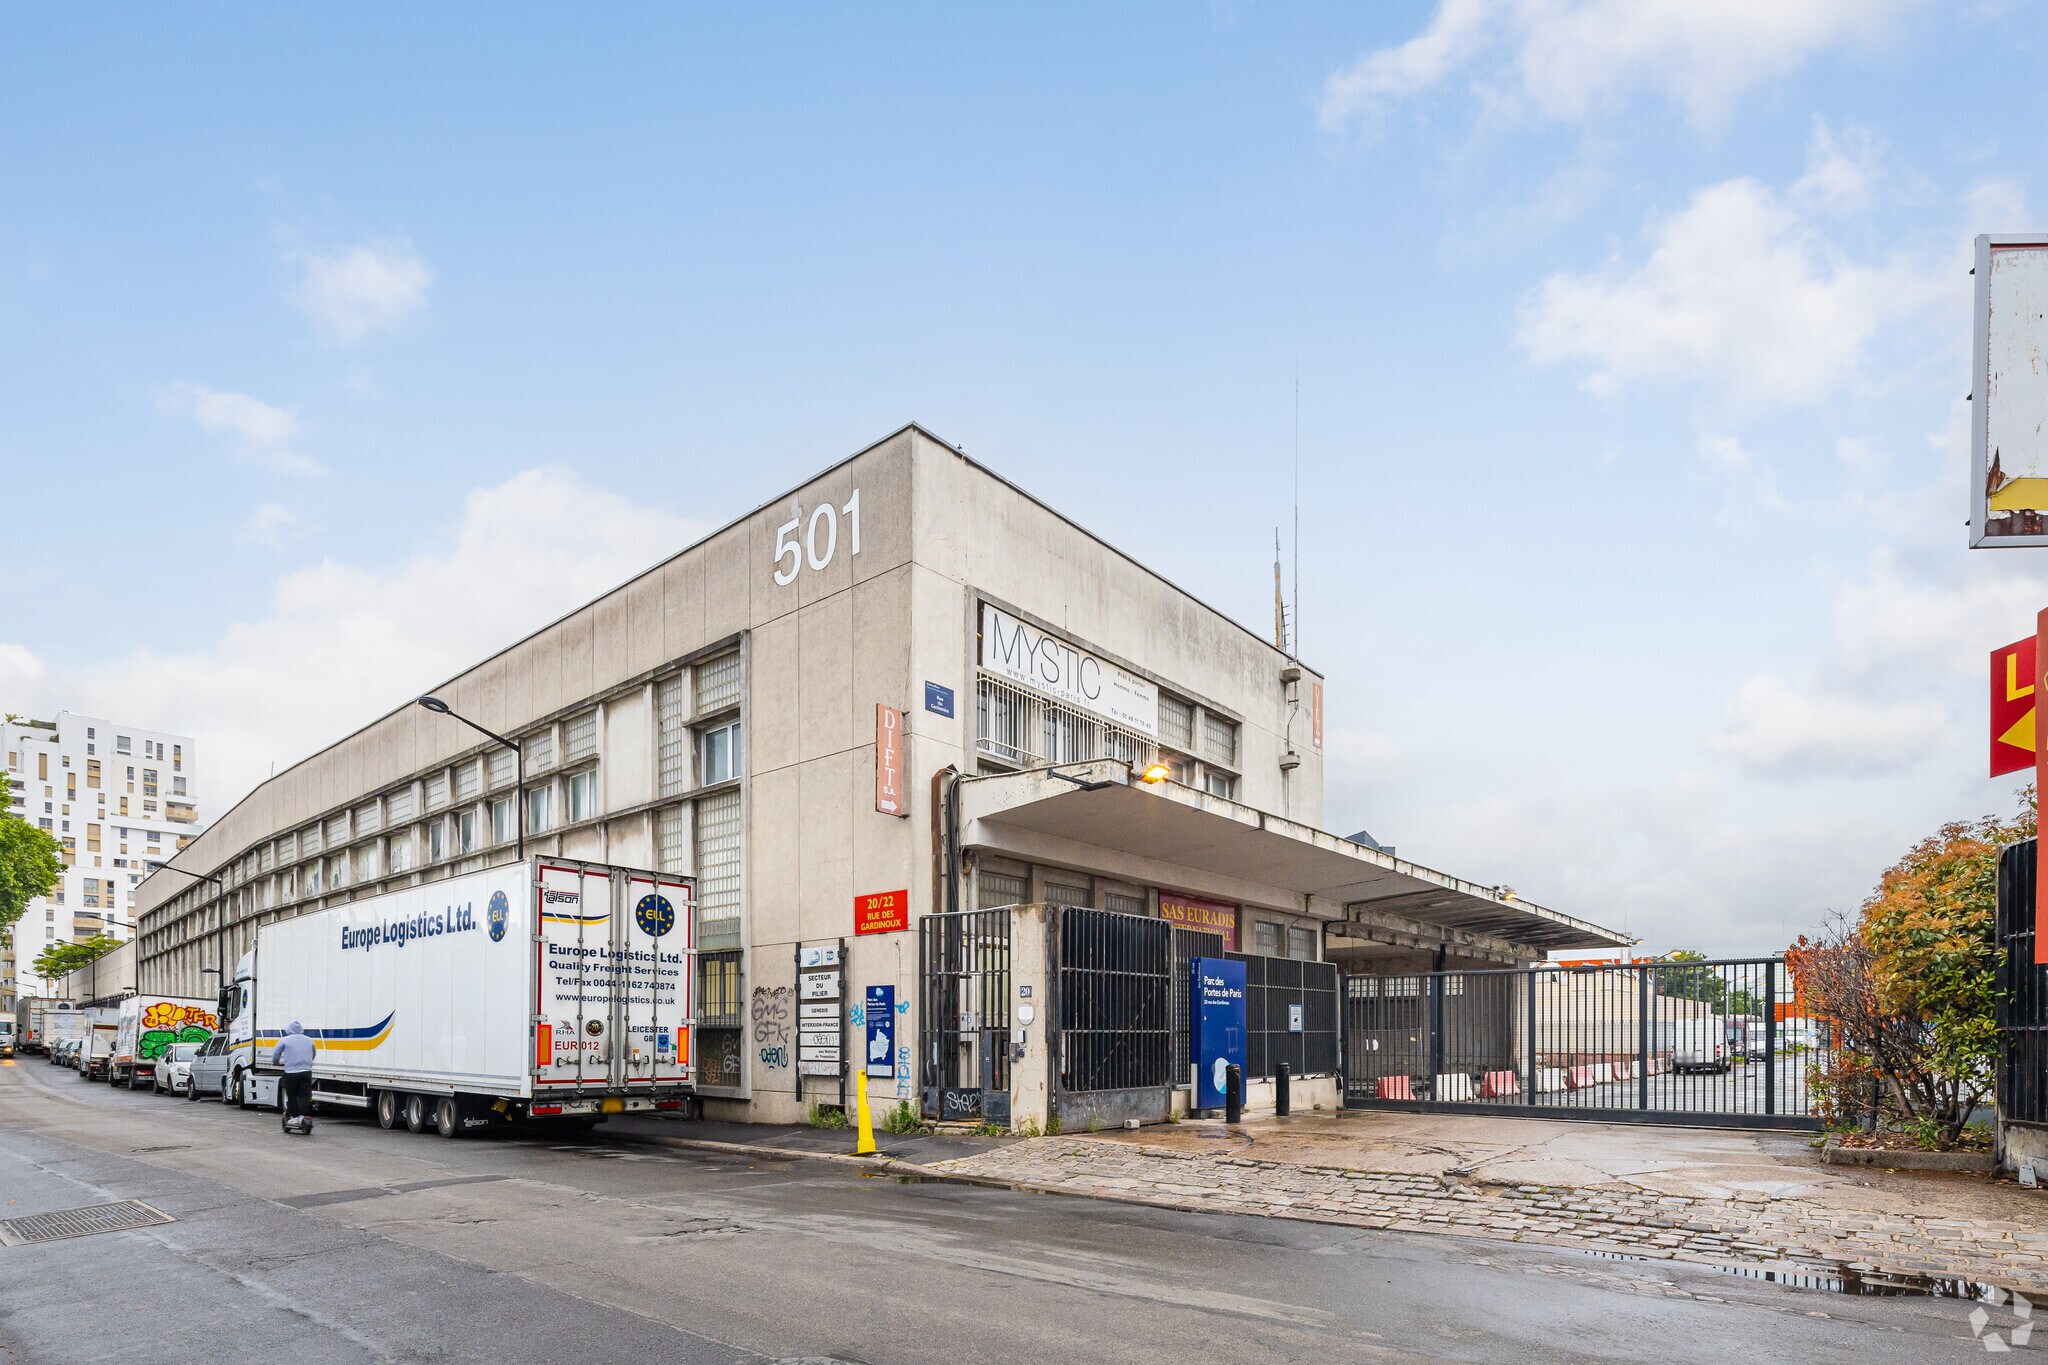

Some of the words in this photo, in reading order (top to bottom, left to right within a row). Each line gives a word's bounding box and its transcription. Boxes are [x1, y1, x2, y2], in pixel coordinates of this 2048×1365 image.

[773, 487, 860, 586] 501
[993, 613, 1101, 700] MYSTIC
[1006, 668, 1090, 707] www.mystic-paris.fr
[884, 710, 896, 786] DIFT
[544, 890, 579, 904] talson
[866, 895, 894, 910] 20/22
[492, 910, 504, 922] ELL
[645, 909, 666, 922] ELL
[867, 912, 880, 920] RUE
[882, 910, 894, 919] DES
[1162, 902, 1184, 920] SAS
[1187, 906, 1235, 928] EURADIS
[342, 926, 380, 952] Europe
[382, 911, 444, 948] Logistics
[446, 902, 476, 934] Ltd.
[860, 919, 901, 930] GARDINOUX
[549, 944, 597, 959] Europe
[600, 947, 657, 962] Logistics
[660, 952, 683, 964] Ltd.
[549, 960, 591, 973] Quality
[594, 964, 632, 975] Freight
[634, 966, 679, 976] Services
[555, 977, 591, 986] Tel/Fax
[644, 982, 675, 990] 740874
[1204, 976, 1215, 985] Parc
[1215, 976, 1224, 986] des
[1021, 987, 1030, 996] 20
[1204, 987, 1221, 997] Portes
[1221, 988, 1229, 997] de
[1229, 988, 1242, 998] Paris
[555, 1041, 578, 1050] EUR
[581, 1042, 599, 1050] 012
